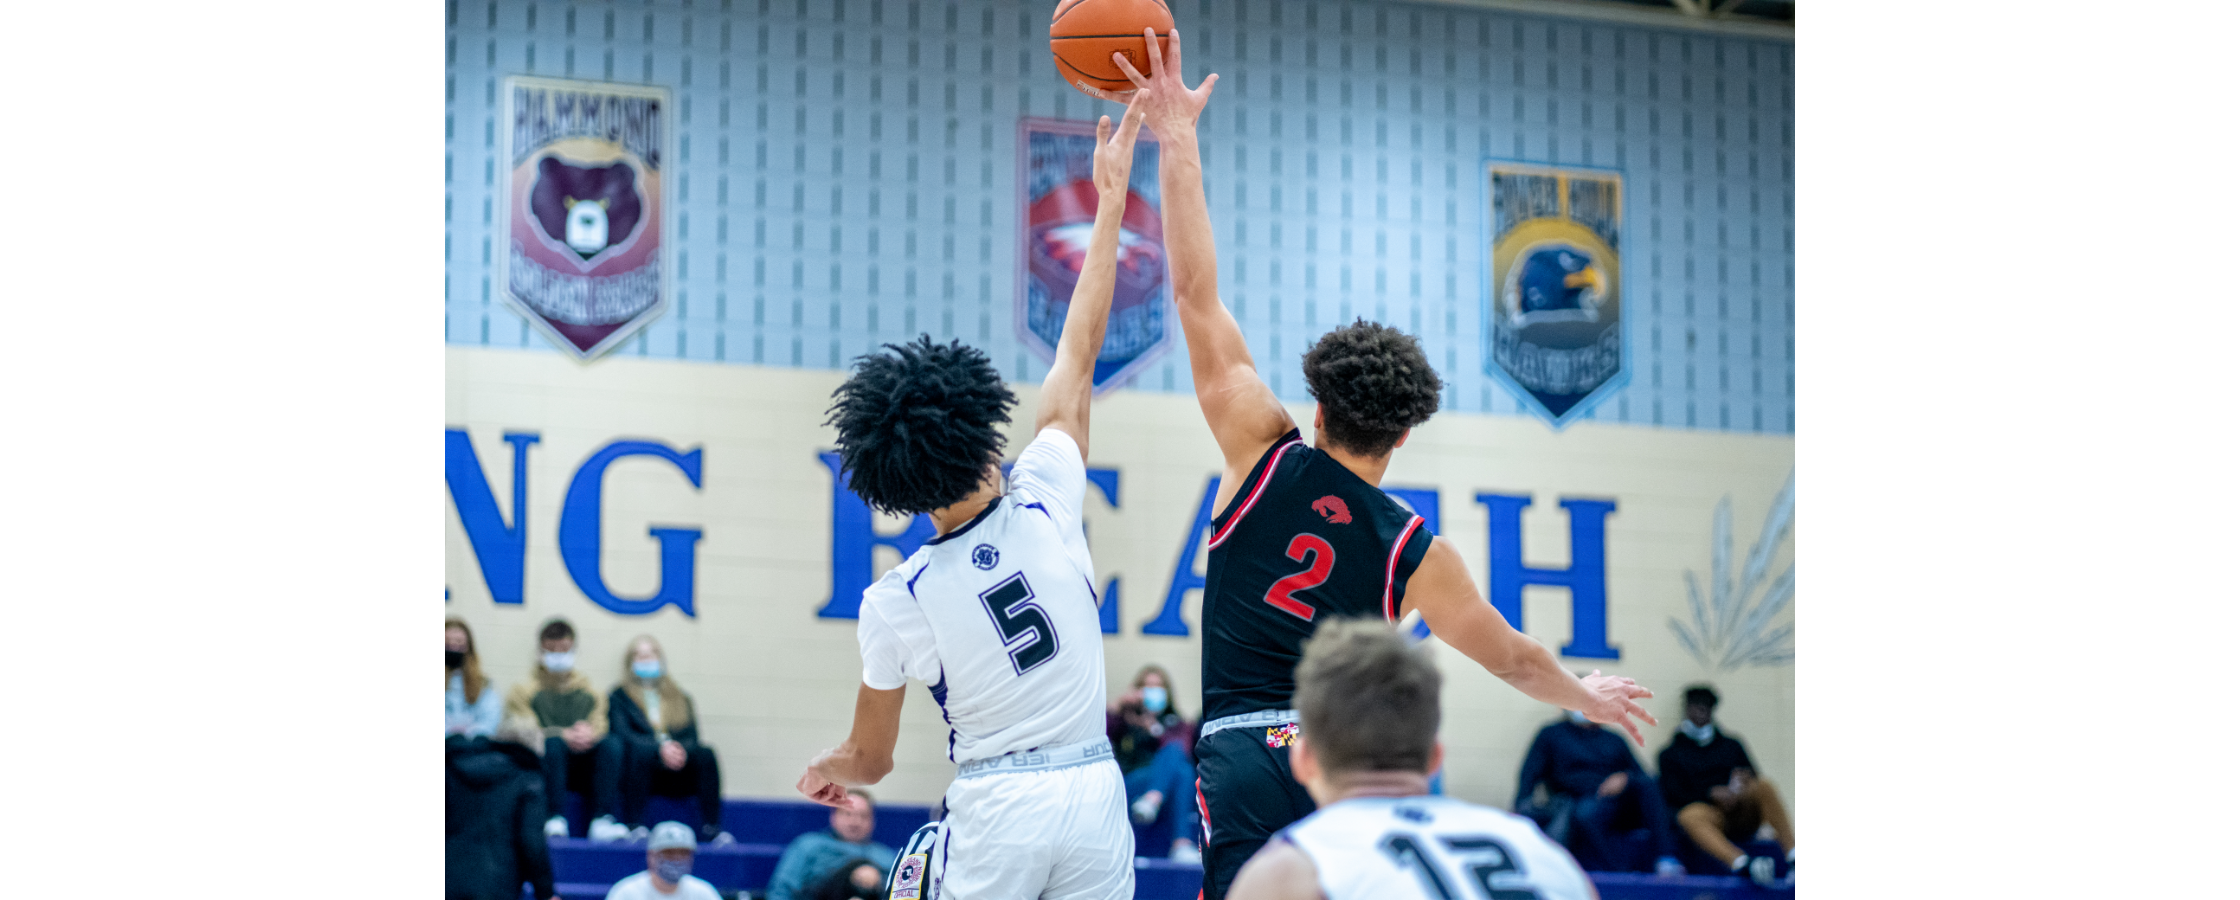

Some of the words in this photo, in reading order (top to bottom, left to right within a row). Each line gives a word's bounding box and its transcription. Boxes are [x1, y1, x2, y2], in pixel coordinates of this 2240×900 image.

[514, 89, 660, 169] HAMMOND
[1263, 533, 1335, 621] 2
[978, 570, 1060, 676] 5
[1376, 829, 1552, 900] 12
